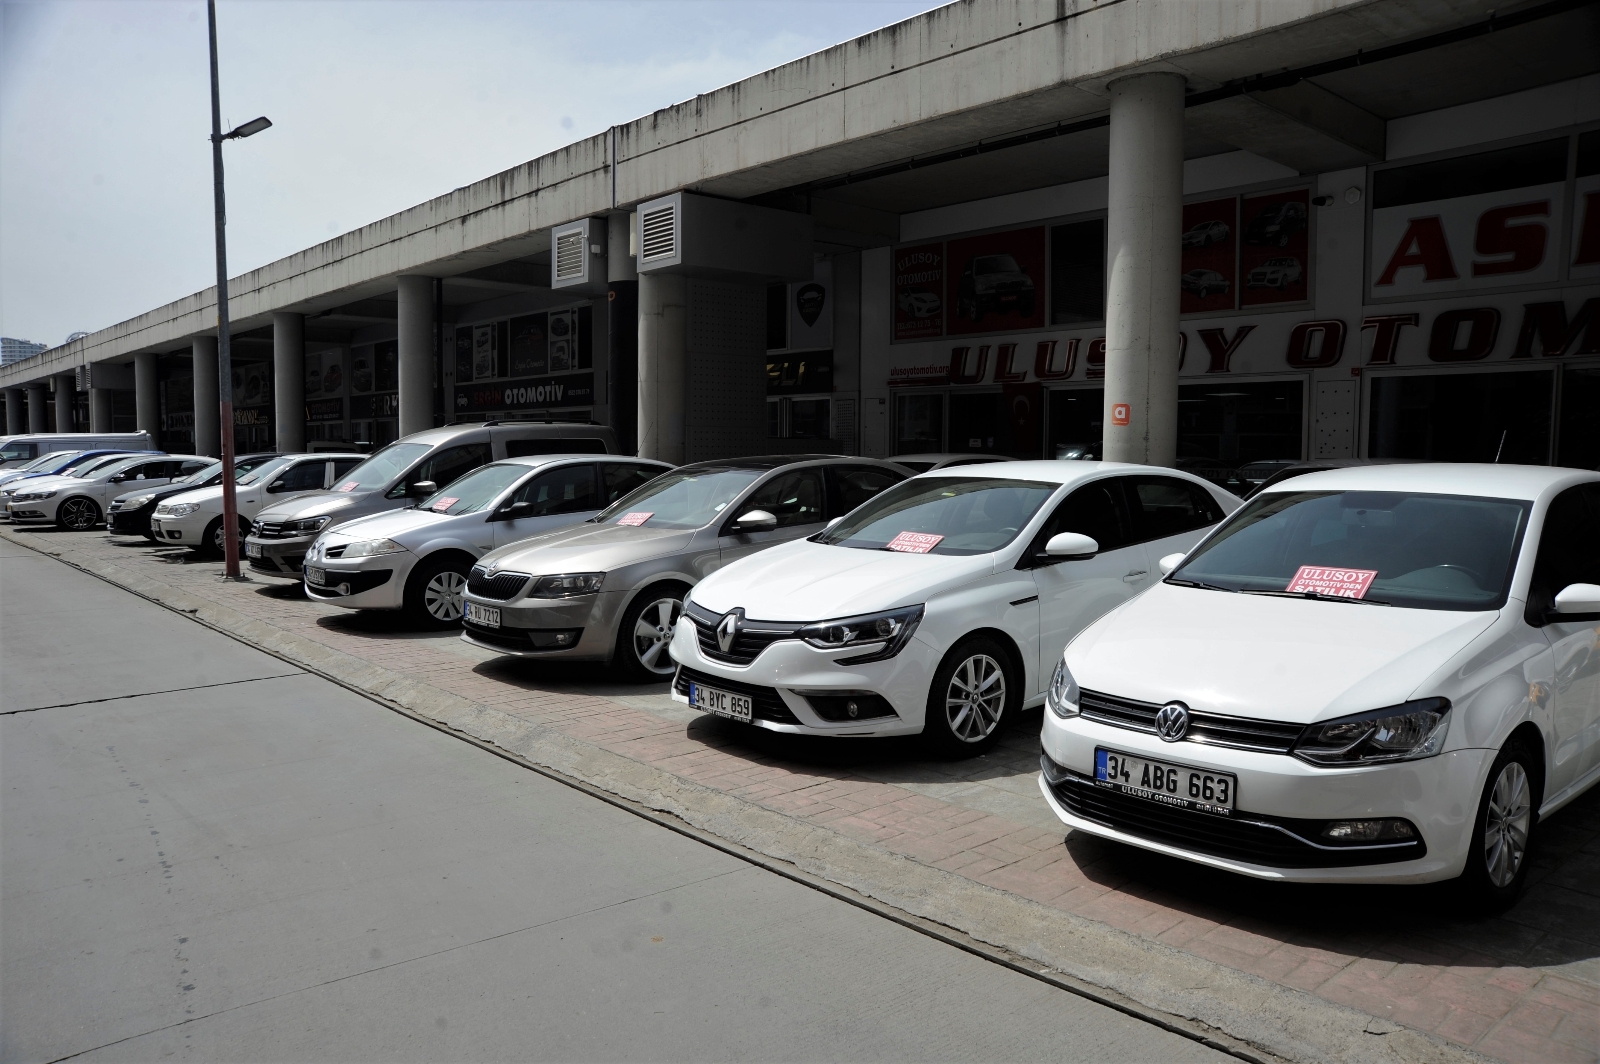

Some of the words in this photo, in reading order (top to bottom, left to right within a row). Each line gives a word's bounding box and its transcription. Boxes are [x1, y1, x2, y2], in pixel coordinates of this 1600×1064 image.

[897, 252, 941, 271] ULUSOY
[890, 364, 950, 378] ulusoyotomotiv.org
[504, 380, 564, 405] OTOMOTİV
[900, 533, 938, 543] ULUSOY
[1302, 569, 1370, 583] ULUSOY
[484, 608, 499, 623] 7212
[695, 687, 705, 704] 34
[709, 690, 727, 710] BYC
[731, 696, 750, 715] 859
[1097, 766, 1106, 775] TR
[1108, 755, 1130, 782] 34
[1141, 763, 1178, 793] ABG
[1188, 773, 1229, 803] 663
[1121, 785, 1153, 799] ULUSOY
